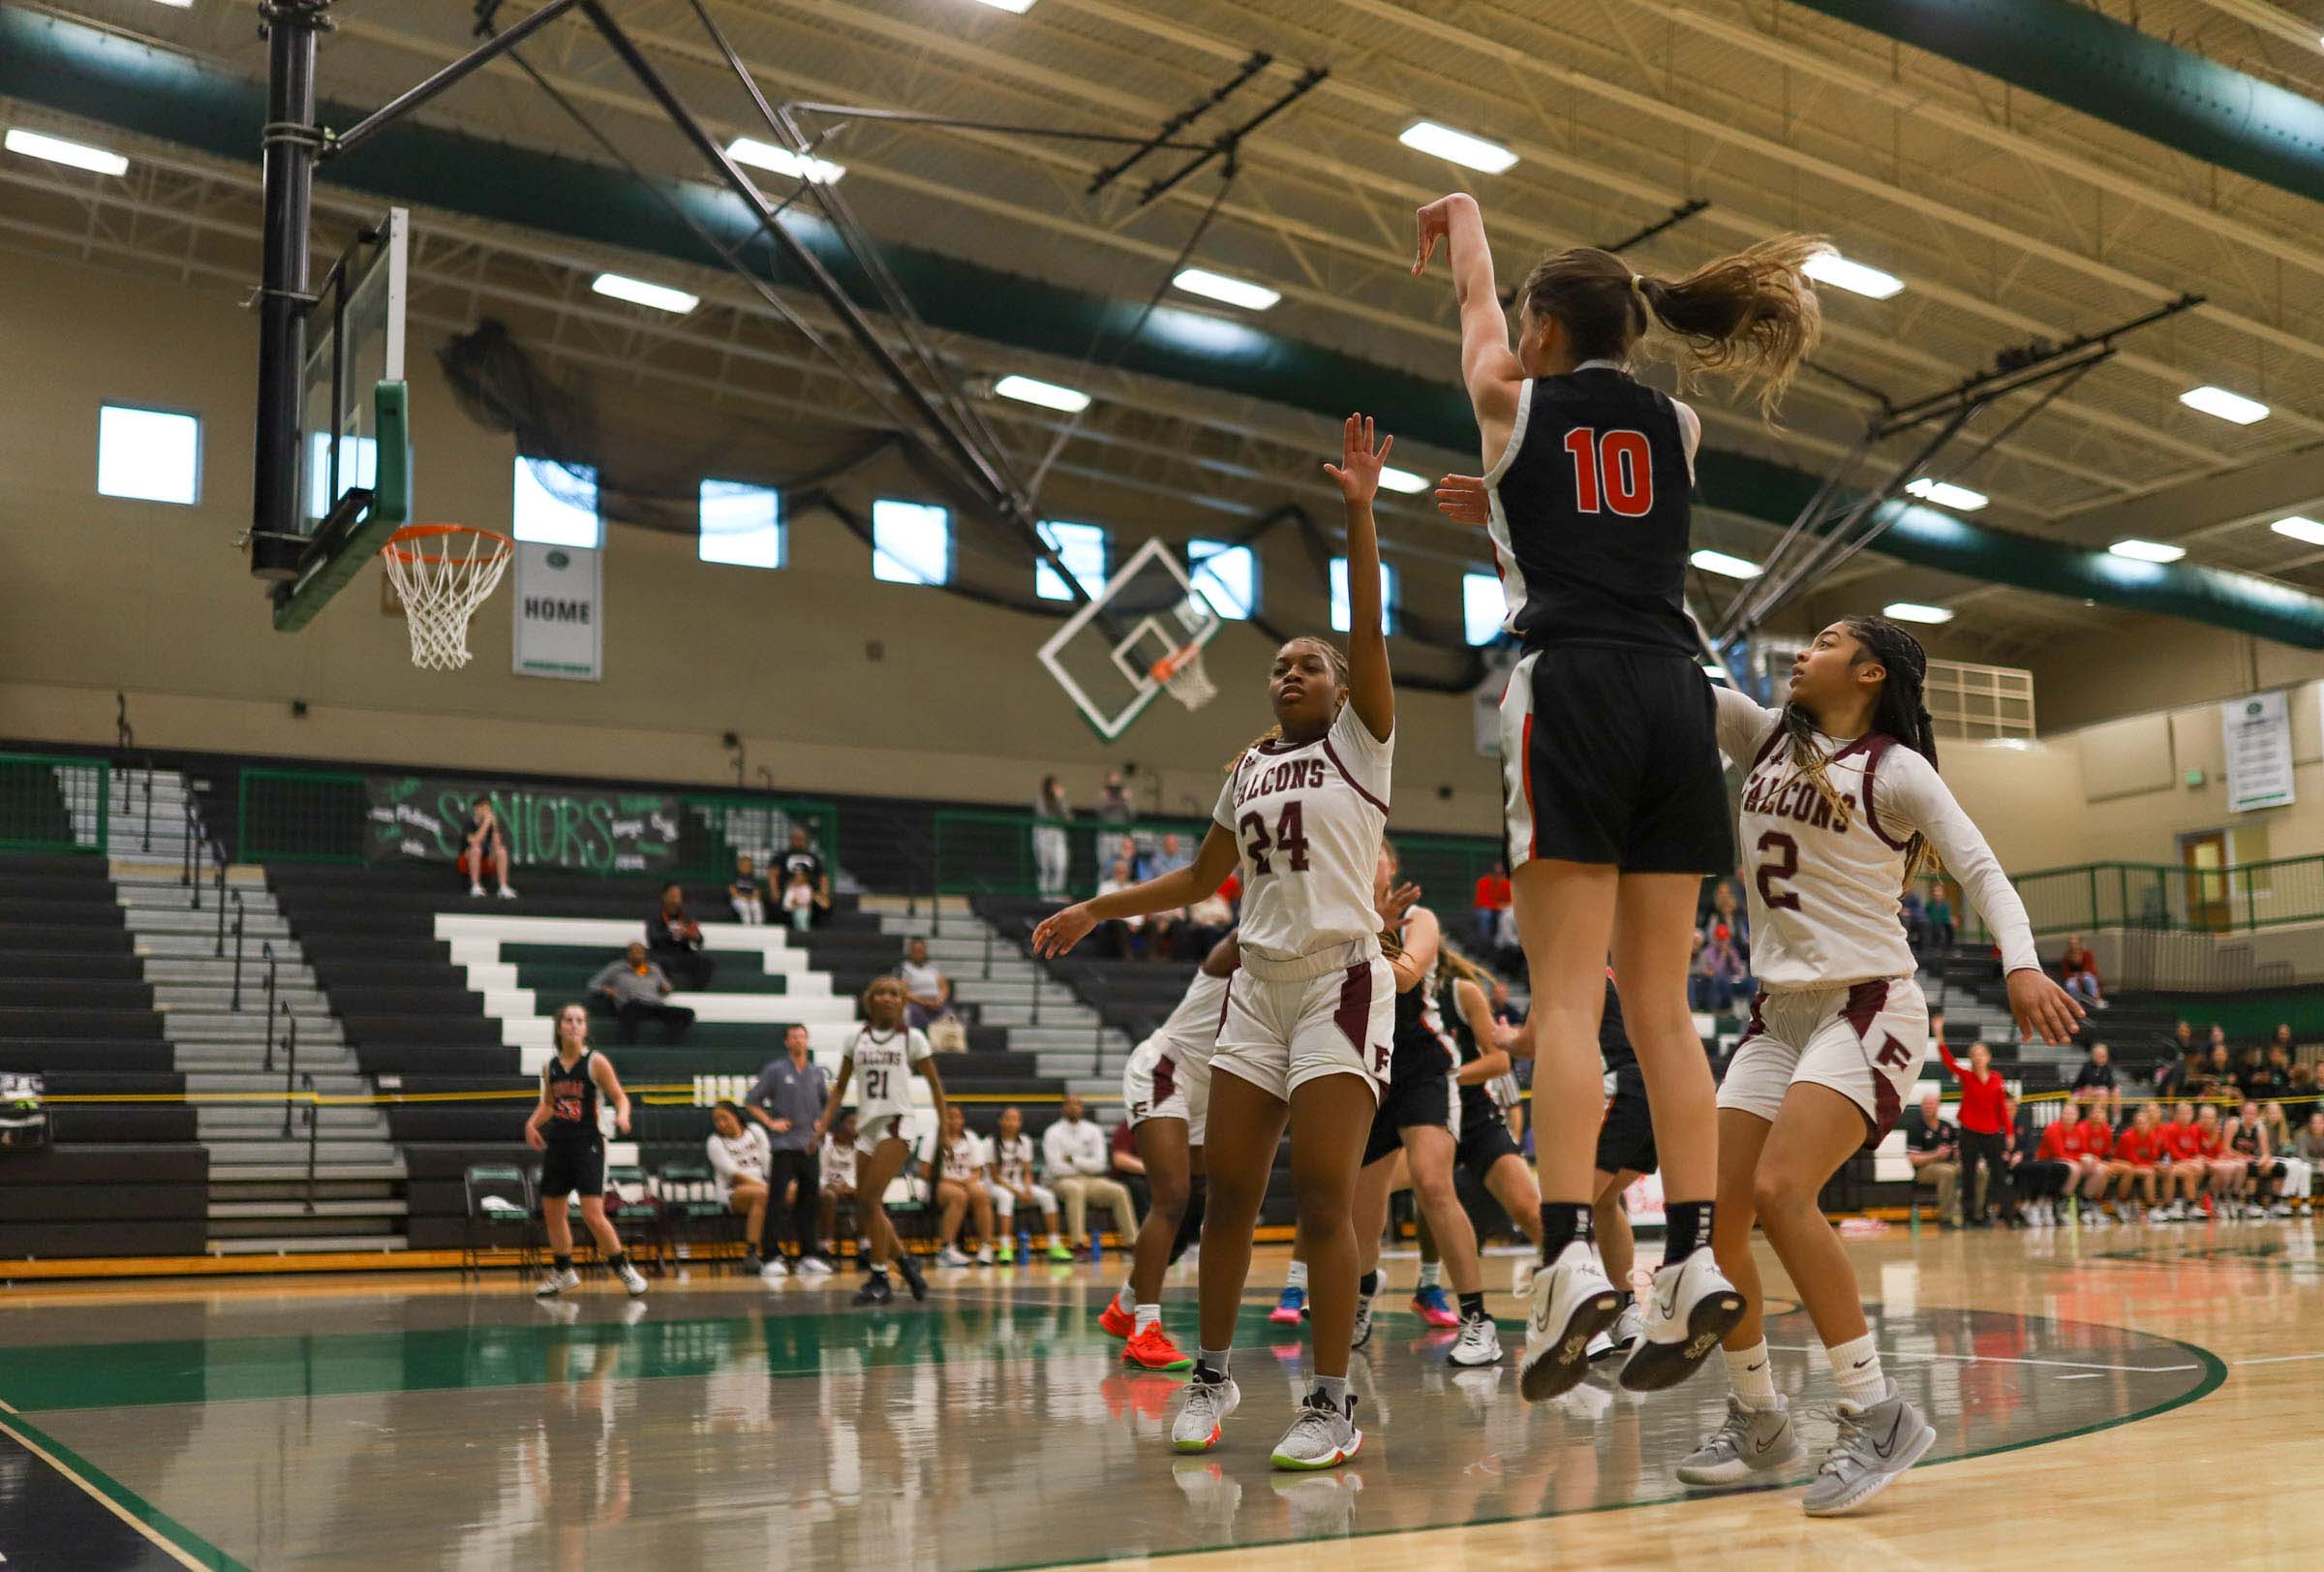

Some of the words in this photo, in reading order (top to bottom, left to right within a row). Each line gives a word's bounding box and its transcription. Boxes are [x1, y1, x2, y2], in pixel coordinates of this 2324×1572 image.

[1564, 427, 1654, 517] 10
[524, 597, 591, 625] HOME
[1237, 758, 1326, 808] ALCONS
[437, 788, 616, 869] SNIORS
[1239, 801, 1310, 875] 24
[1757, 830, 1802, 912] 2
[1372, 1042, 1391, 1072] F
[1876, 1028, 1912, 1072] F
[867, 1069, 889, 1099] 21
